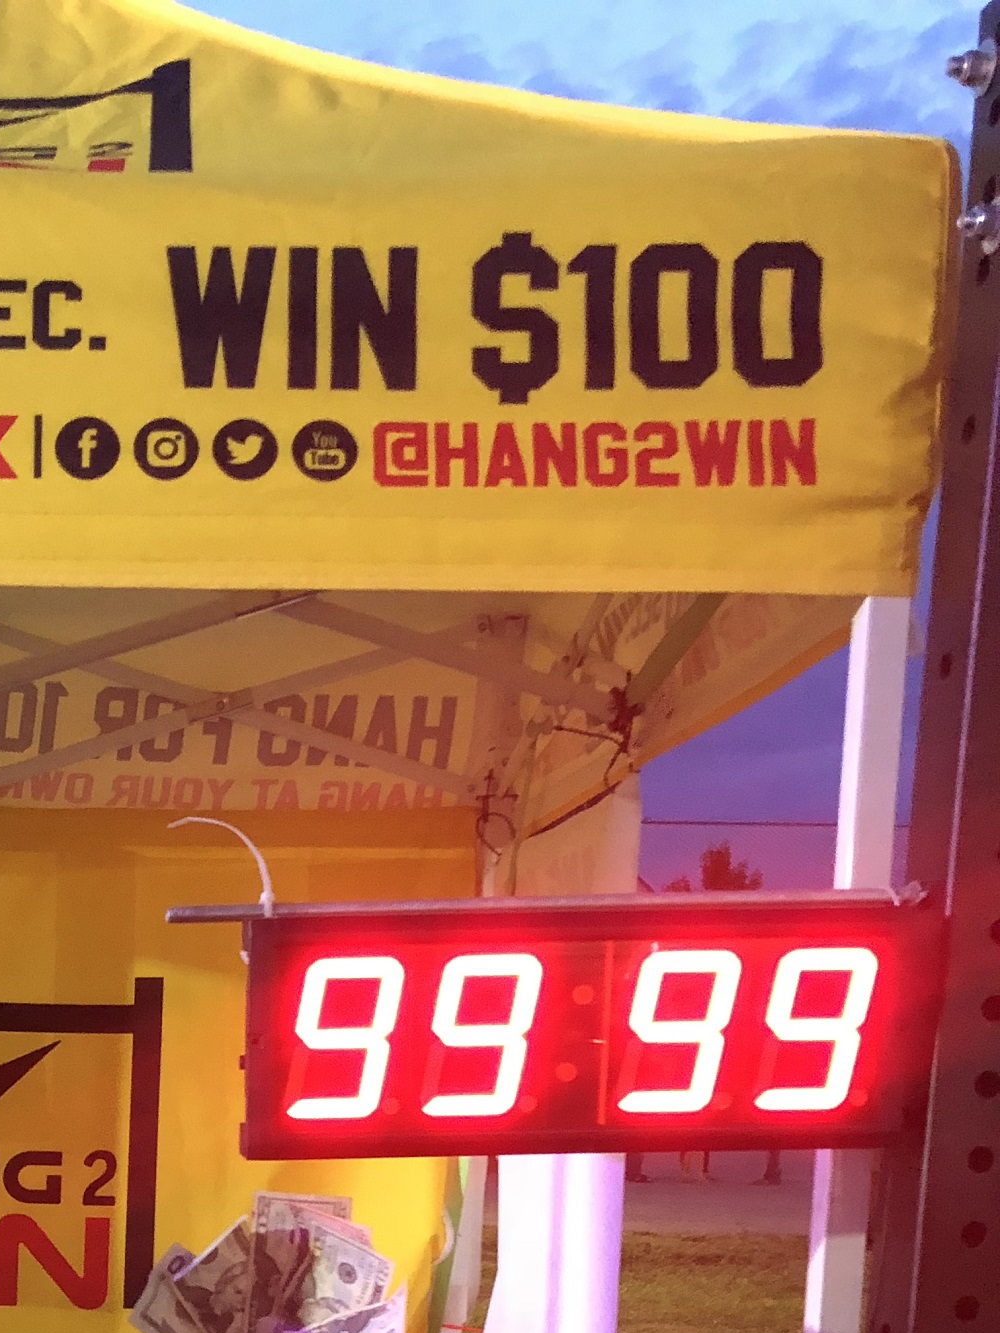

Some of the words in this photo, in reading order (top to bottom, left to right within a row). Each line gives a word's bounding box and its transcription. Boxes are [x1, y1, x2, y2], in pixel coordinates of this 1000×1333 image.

[166, 245, 418, 392] WIN
[471, 231, 823, 405] $100
[373, 418, 816, 488] @HANG2WIN
[82, 1150, 117, 1206] 2
